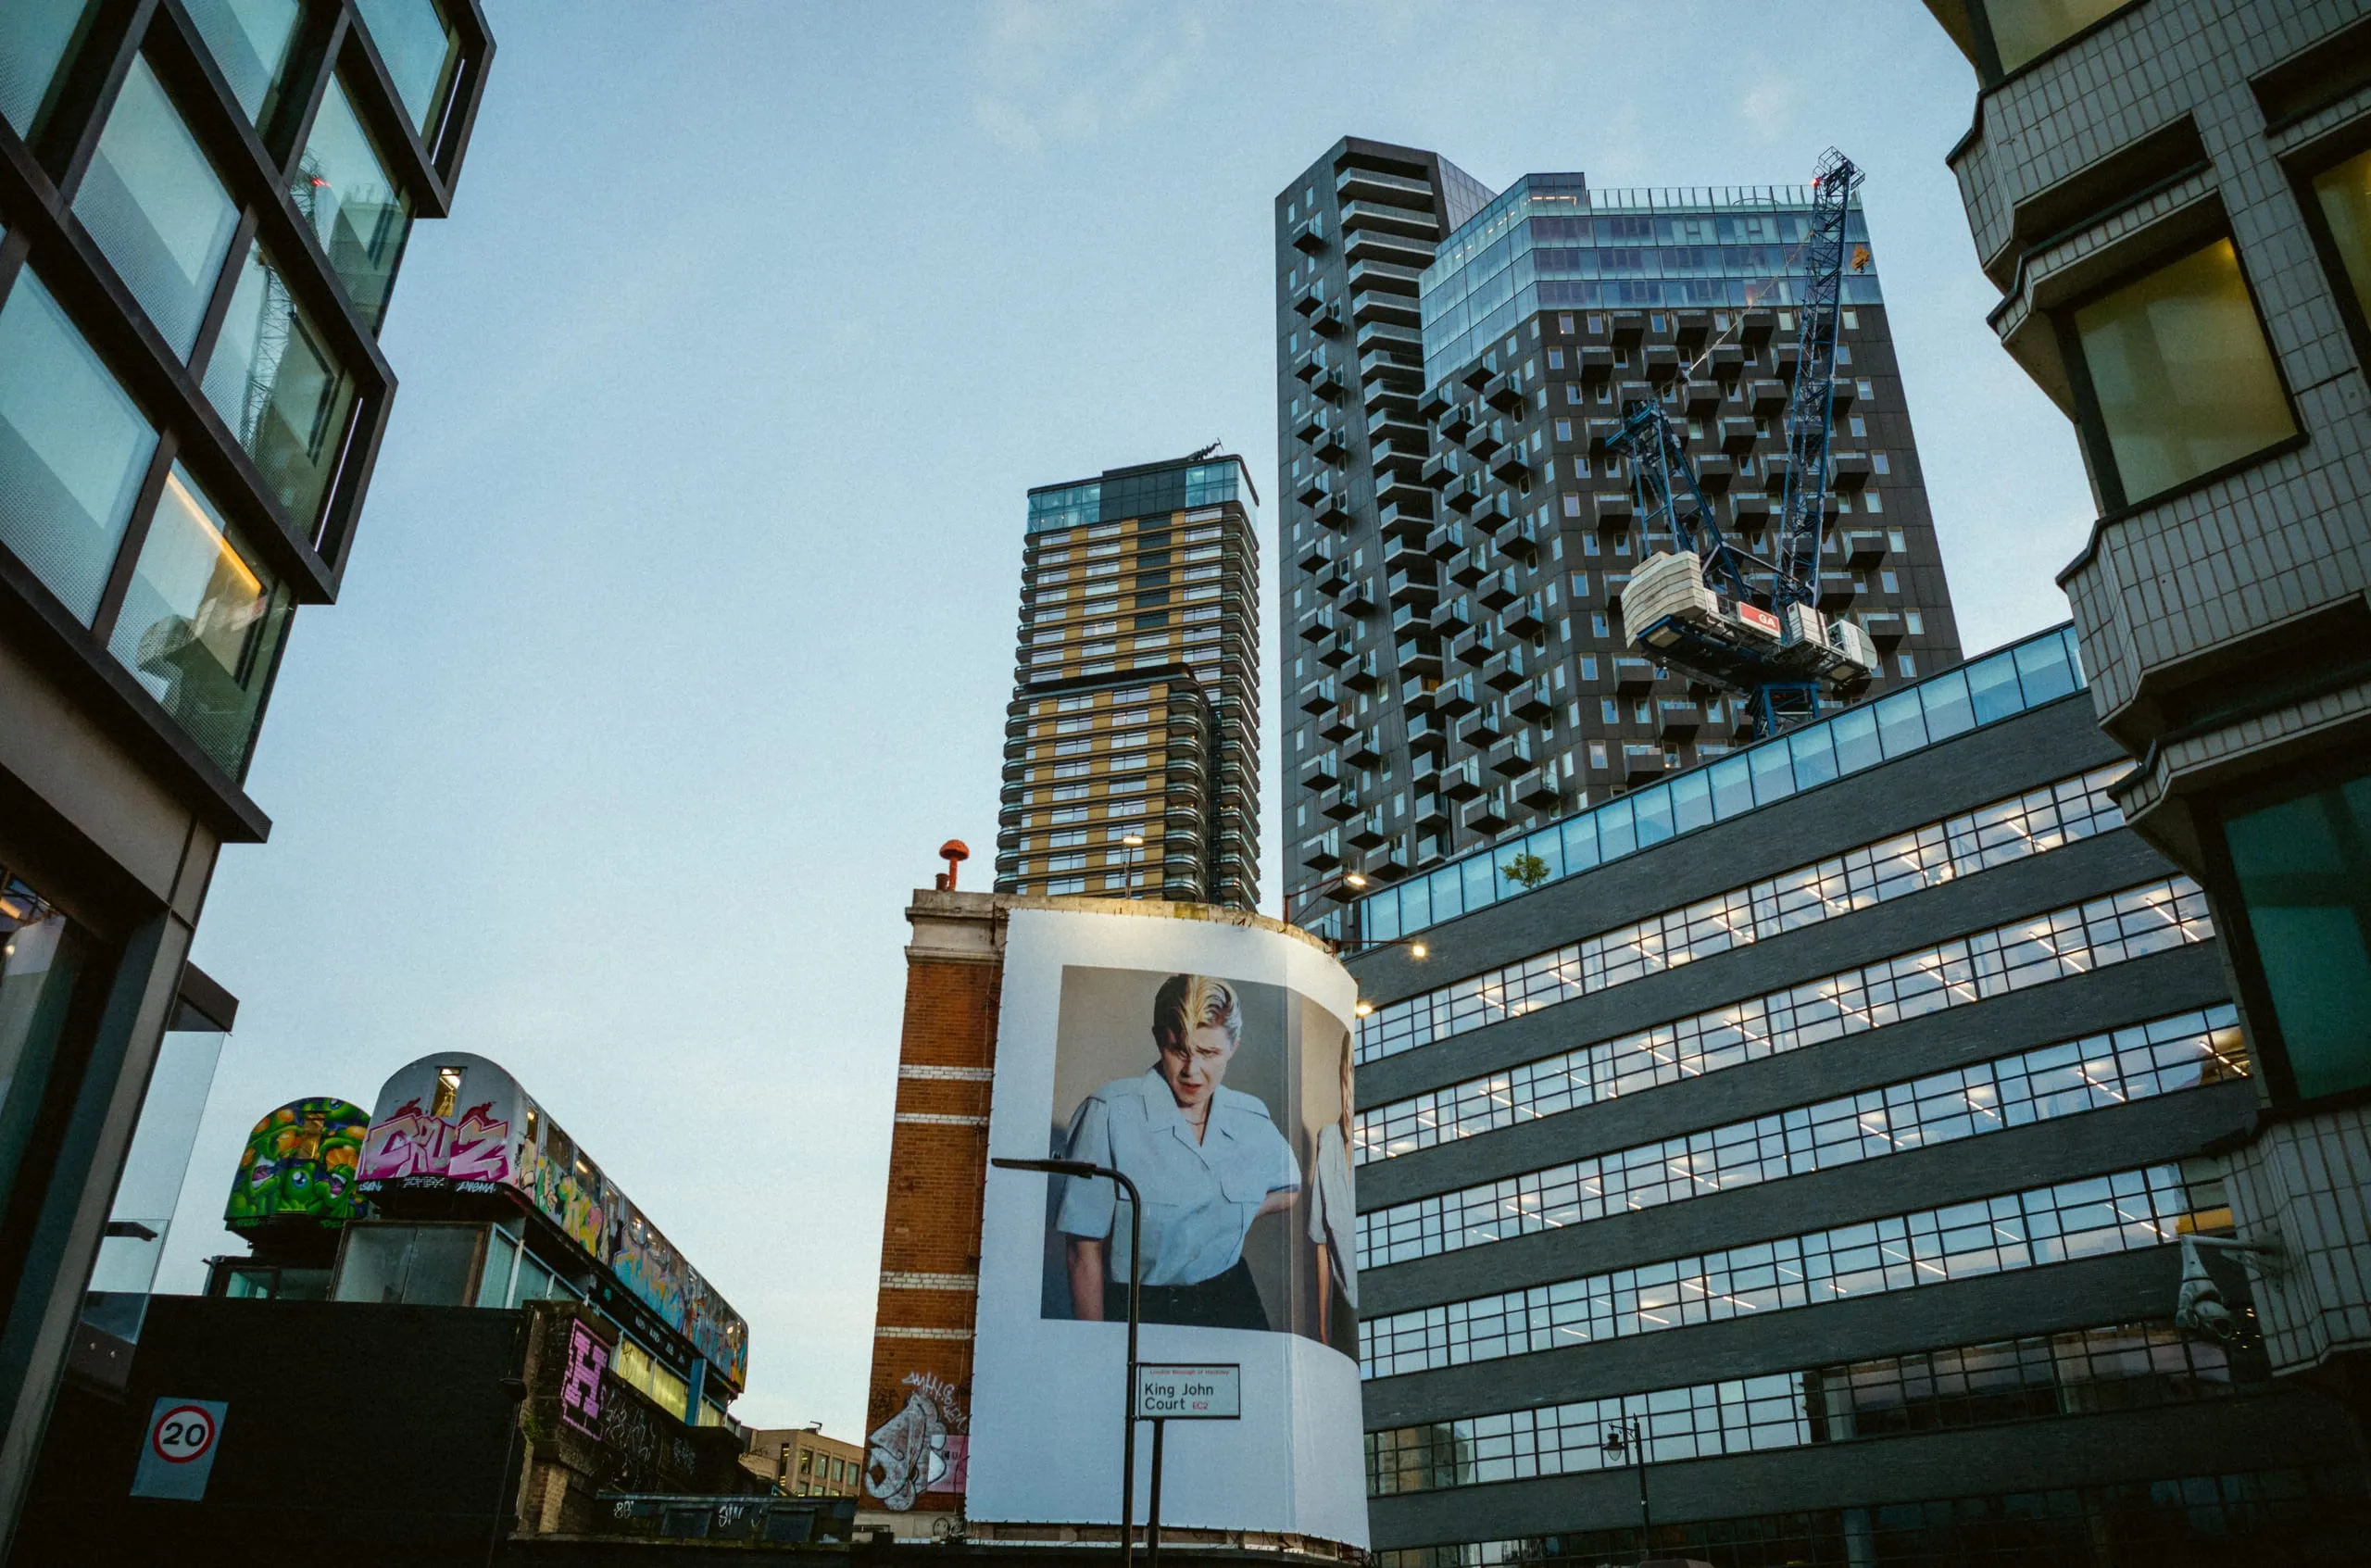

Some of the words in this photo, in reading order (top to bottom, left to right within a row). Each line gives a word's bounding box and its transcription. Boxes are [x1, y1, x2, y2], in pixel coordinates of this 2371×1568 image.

[1759, 614, 1776, 628] GA
[1145, 1383, 1174, 1398] King
[1182, 1383, 1213, 1396] John
[1145, 1398, 1186, 1411] Court
[1192, 1401, 1209, 1410] EC2
[162, 1422, 206, 1447] 20
